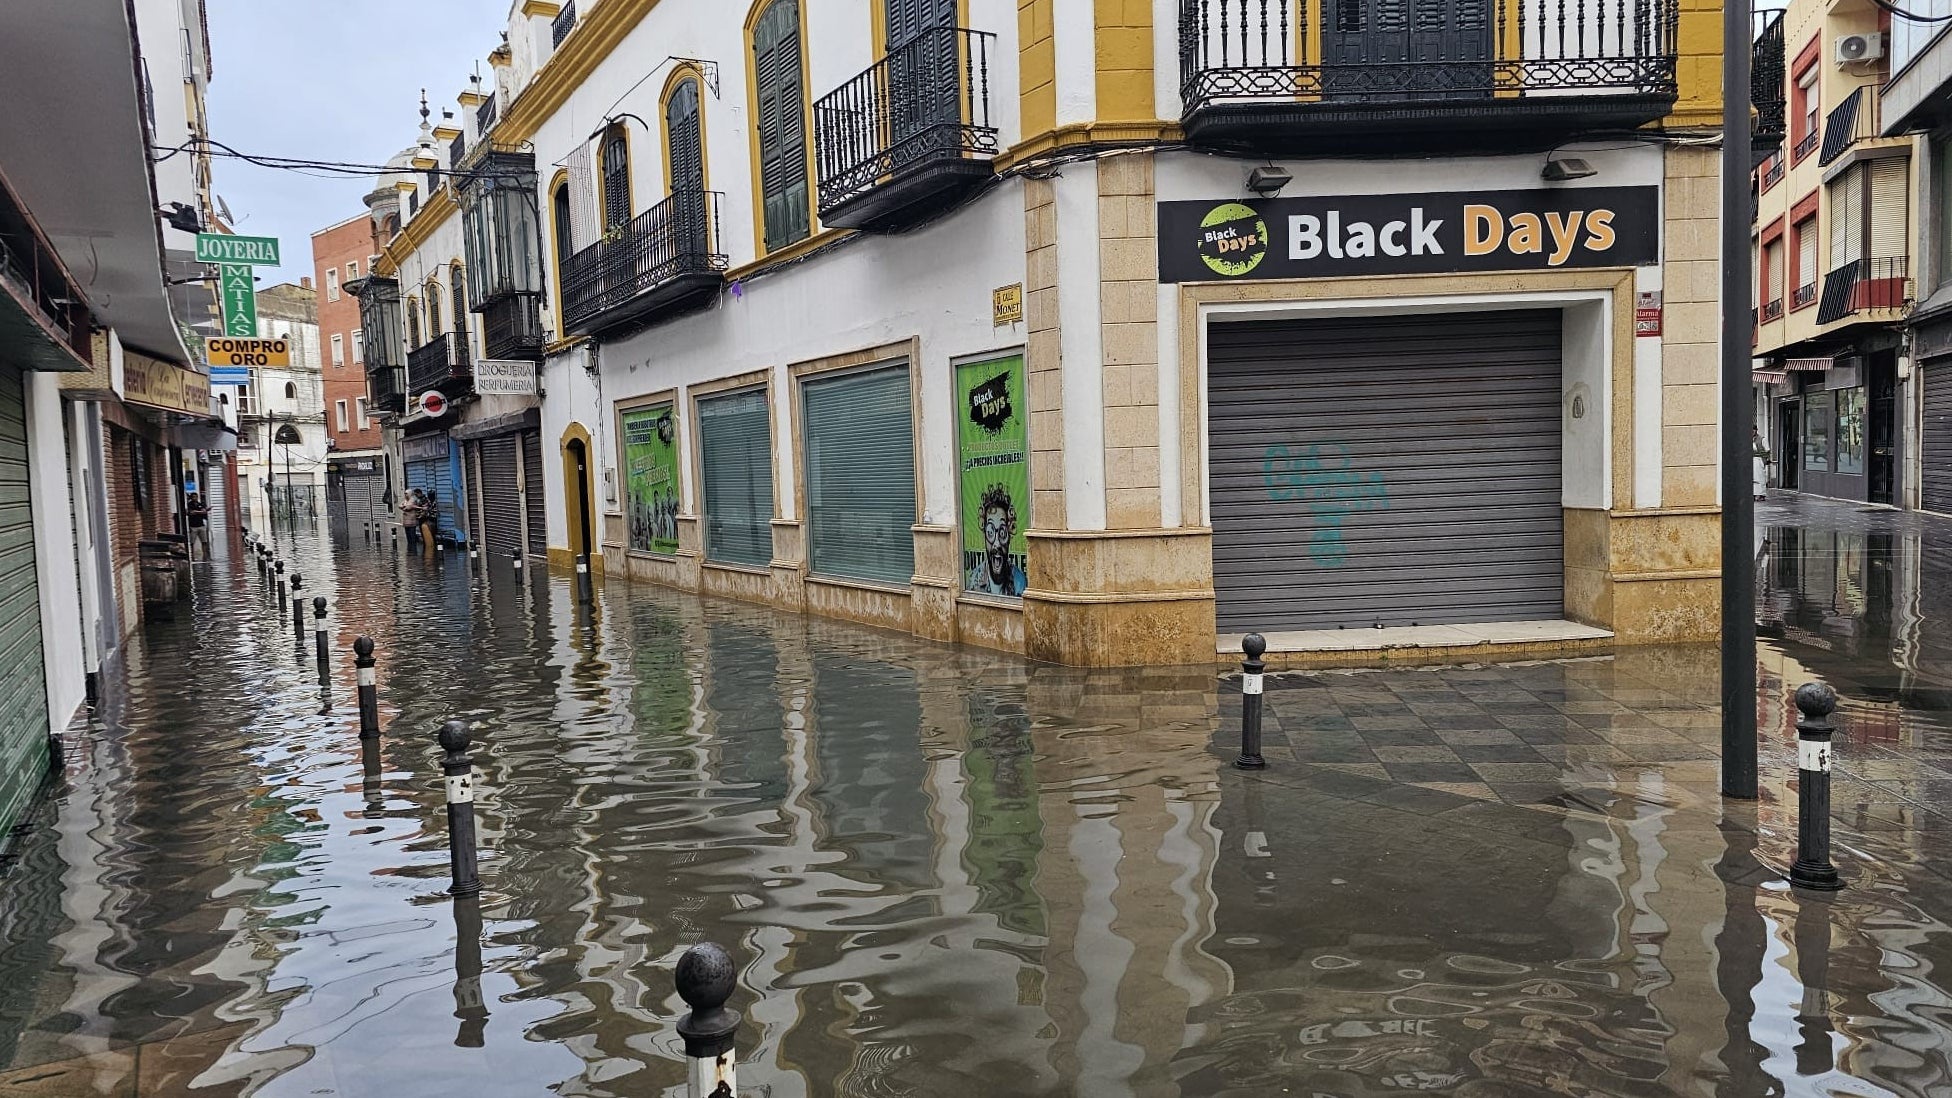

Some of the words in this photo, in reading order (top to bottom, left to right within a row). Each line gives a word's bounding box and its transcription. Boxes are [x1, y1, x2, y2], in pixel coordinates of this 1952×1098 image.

[1204, 227, 1237, 243] Black
[1217, 234, 1257, 253] Days
[1288, 207, 1445, 261] Black
[1463, 204, 1616, 266] Days
[199, 238, 277, 260] JOYERIA
[227, 265, 252, 336] MATIAS
[996, 303, 1019, 315] MONET
[209, 339, 285, 353] COMPRO
[230, 353, 268, 365] ORO
[973, 388, 993, 407] Black
[981, 396, 1005, 418] Days
